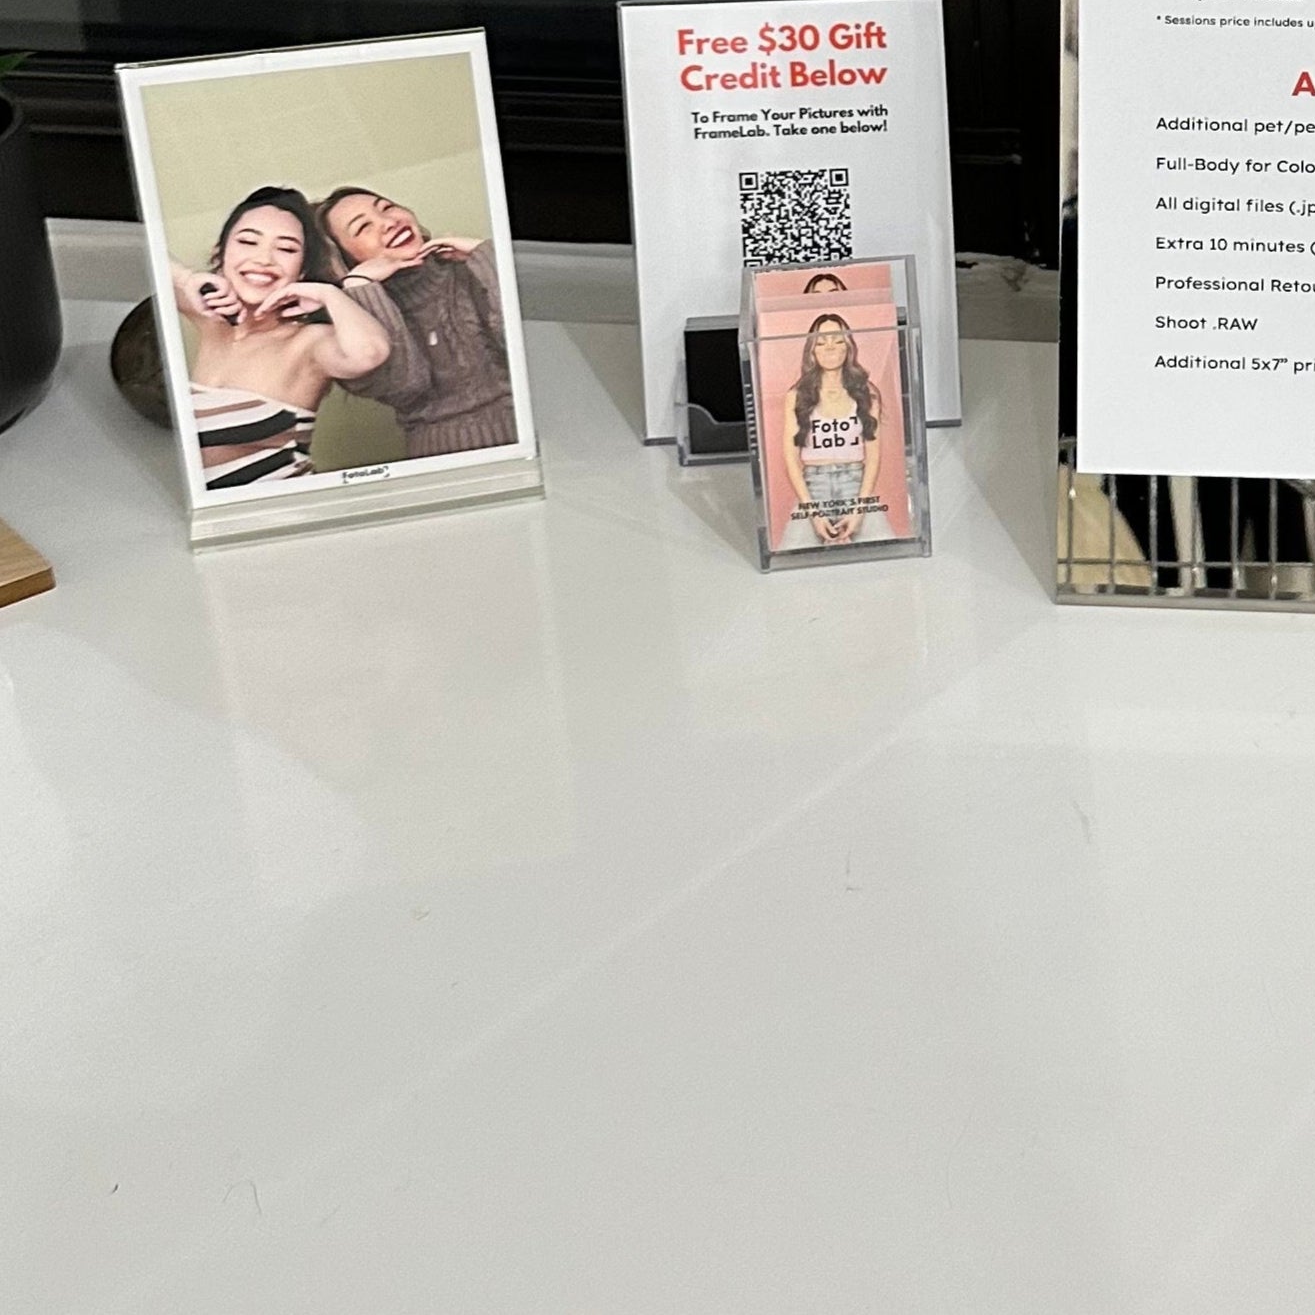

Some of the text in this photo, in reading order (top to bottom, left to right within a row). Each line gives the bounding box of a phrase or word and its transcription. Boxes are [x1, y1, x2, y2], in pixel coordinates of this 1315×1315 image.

[1164, 15, 1216, 26] Sessions
[1219, 16, 1251, 28] price
[1253, 17, 1304, 28] includes
[678, 22, 887, 56] Free $30 Gift
[681, 59, 887, 91] Credit Below
[690, 103, 889, 124] To Frame Your Pictures with
[694, 119, 888, 139] FrameLab. Take one below!
[1155, 117, 1248, 132] Additional
[1157, 158, 1239, 174] Full-Body
[1245, 158, 1272, 173] for
[1155, 196, 1177, 210] All
[1183, 198, 1239, 214] digital
[1245, 198, 1284, 213] files
[1155, 236, 1204, 251] Extra
[1210, 238, 1228, 251] 10
[1233, 240, 1305, 254] minutes
[1156, 277, 1264, 291] Professional
[1155, 315, 1258, 331] Shoot .RAW
[1154, 355, 1246, 370] Additional
[811, 419, 850, 433] Foto
[813, 434, 845, 449] Lab
[857, 495, 881, 506] FIRST
[856, 503, 889, 516] STUDIO
